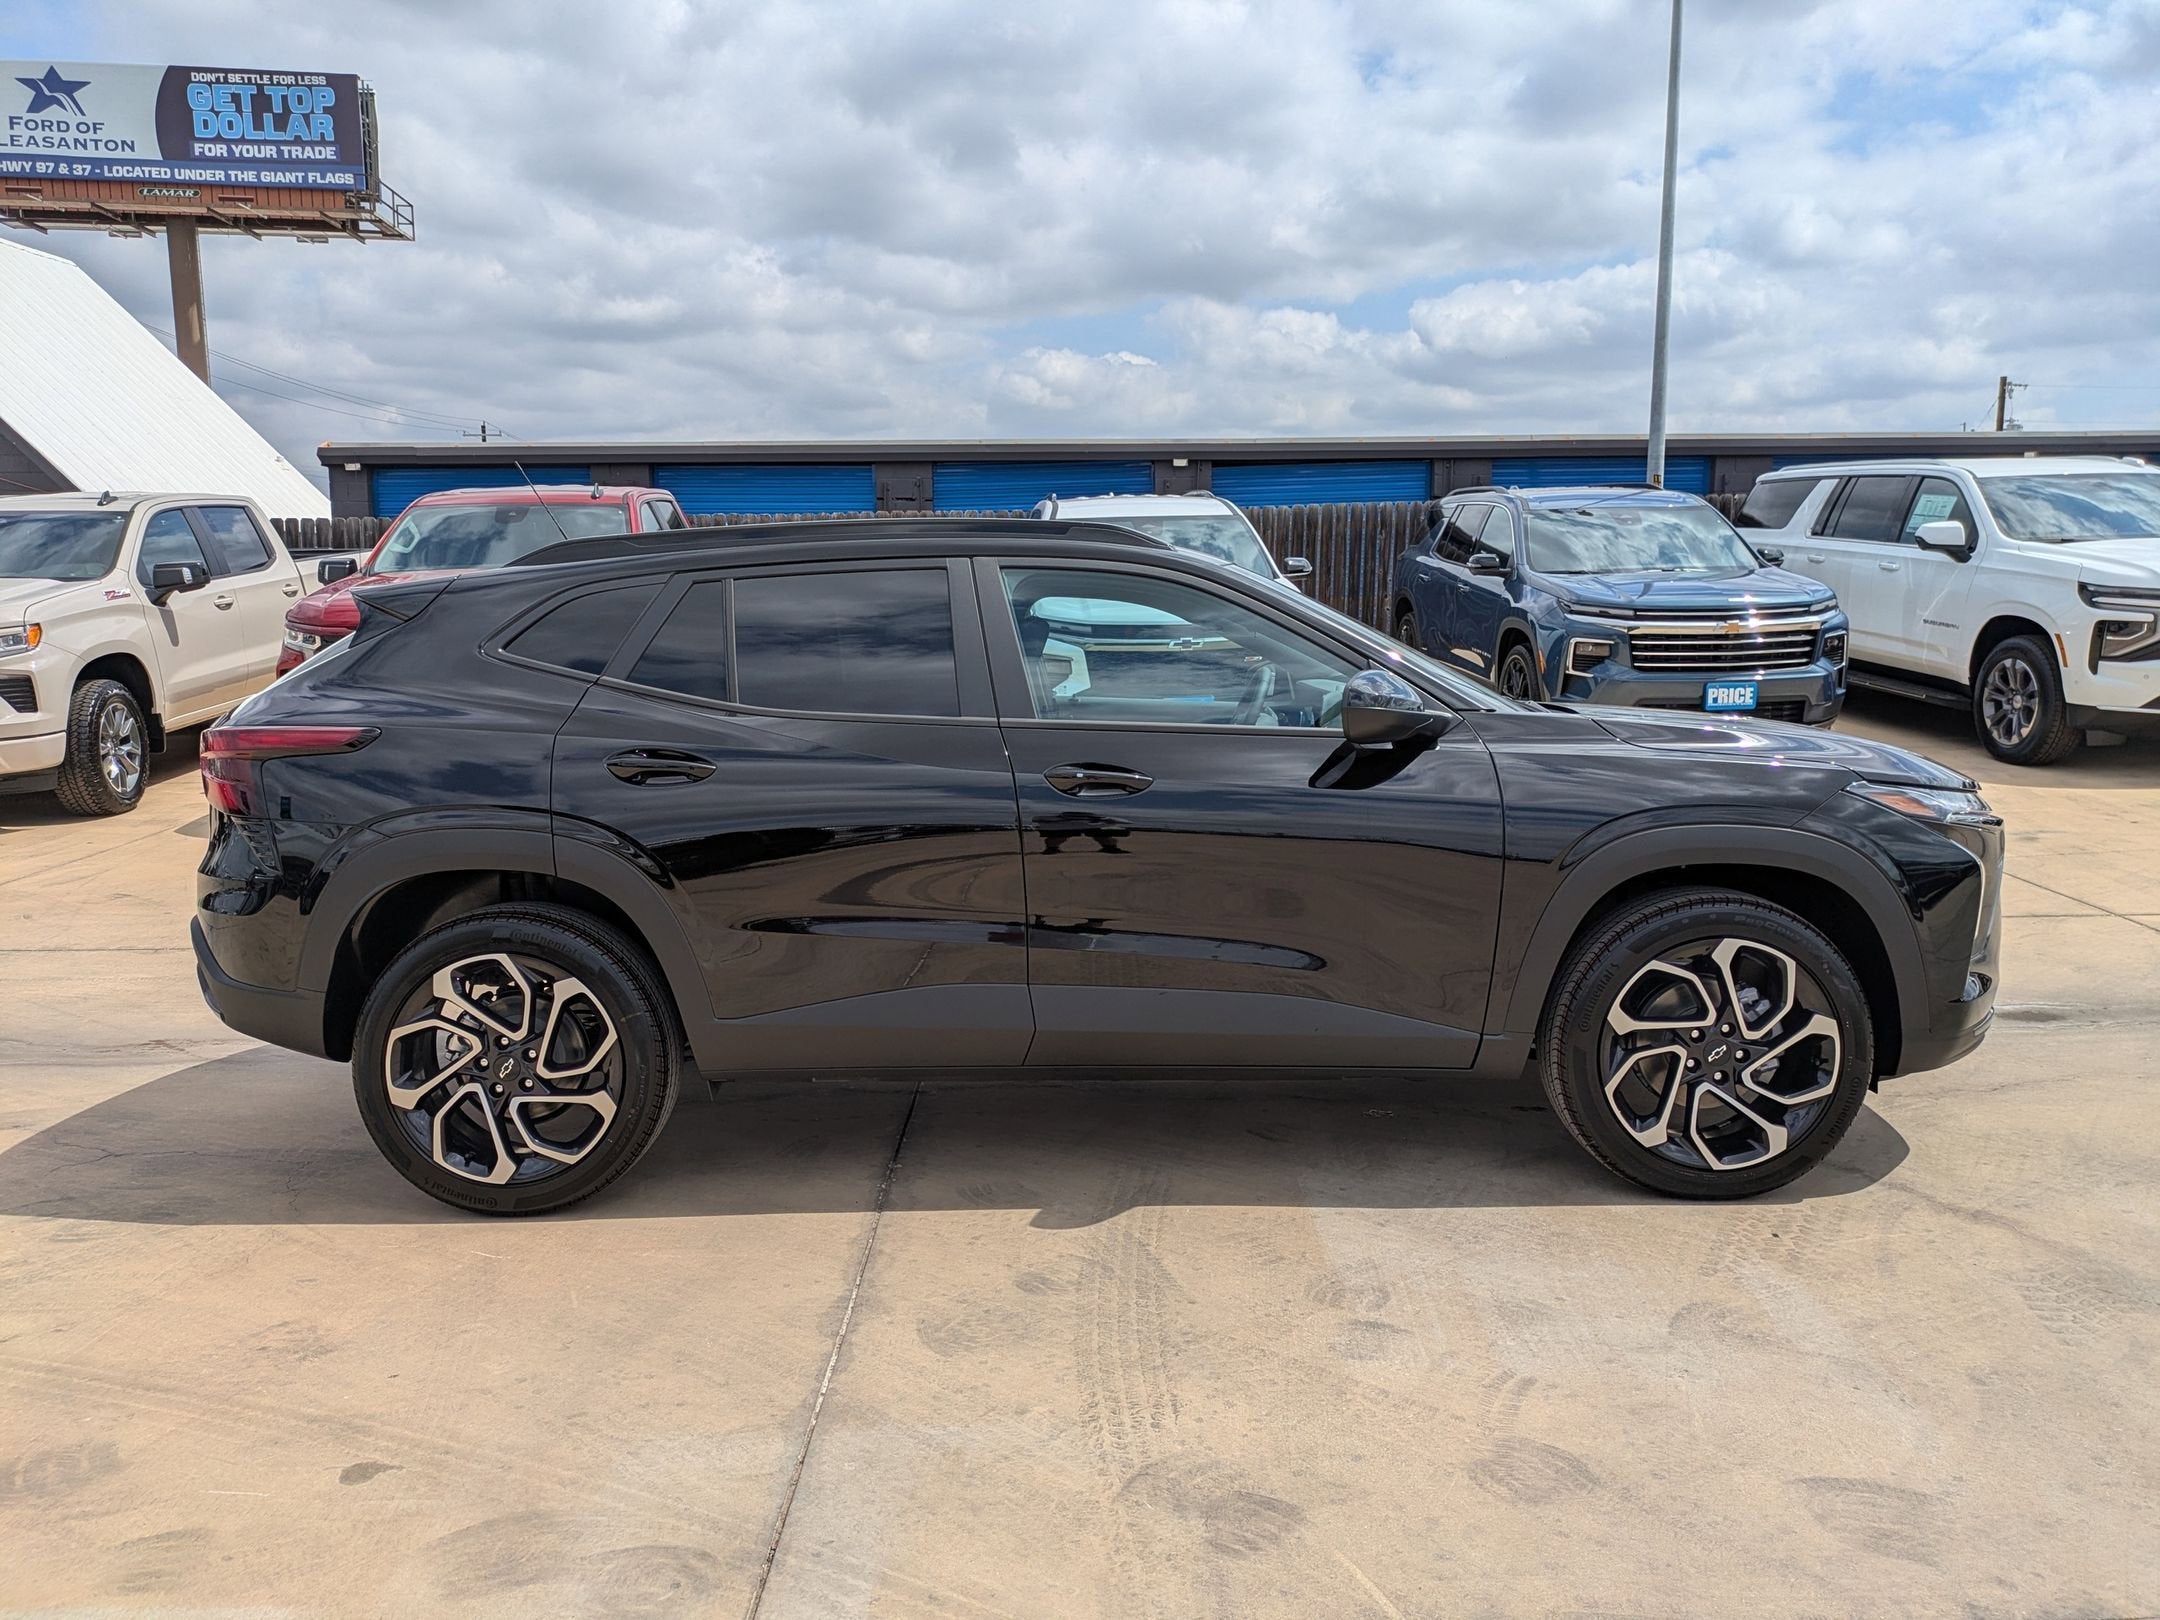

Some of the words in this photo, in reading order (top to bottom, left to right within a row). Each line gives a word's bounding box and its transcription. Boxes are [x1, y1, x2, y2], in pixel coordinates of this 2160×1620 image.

[190, 71, 225, 83] DON'T
[227, 73, 271, 84] SETTLE
[273, 74, 296, 85] FOR
[298, 75, 327, 85] LESS
[187, 83, 257, 112] GET
[264, 85, 336, 114] TOP
[8, 115, 71, 133] FORD
[75, 121, 105, 135] OF
[192, 110, 335, 141] DOLLAR
[193, 143, 228, 157] FOR
[230, 144, 277, 158] YOUR
[280, 145, 336, 159] TRADE
[35, 161, 55, 174] 97
[58, 162, 70, 175] &
[72, 164, 92, 176] 37
[103, 165, 171, 179] LOCATED
[174, 168, 226, 181] UNDER
[228, 170, 258, 182] THE
[260, 171, 305, 183] GIANT
[307, 172, 354, 185] FLAGS
[143, 188, 195, 197] LAMAR
[1707, 687, 1754, 704] PRICE
